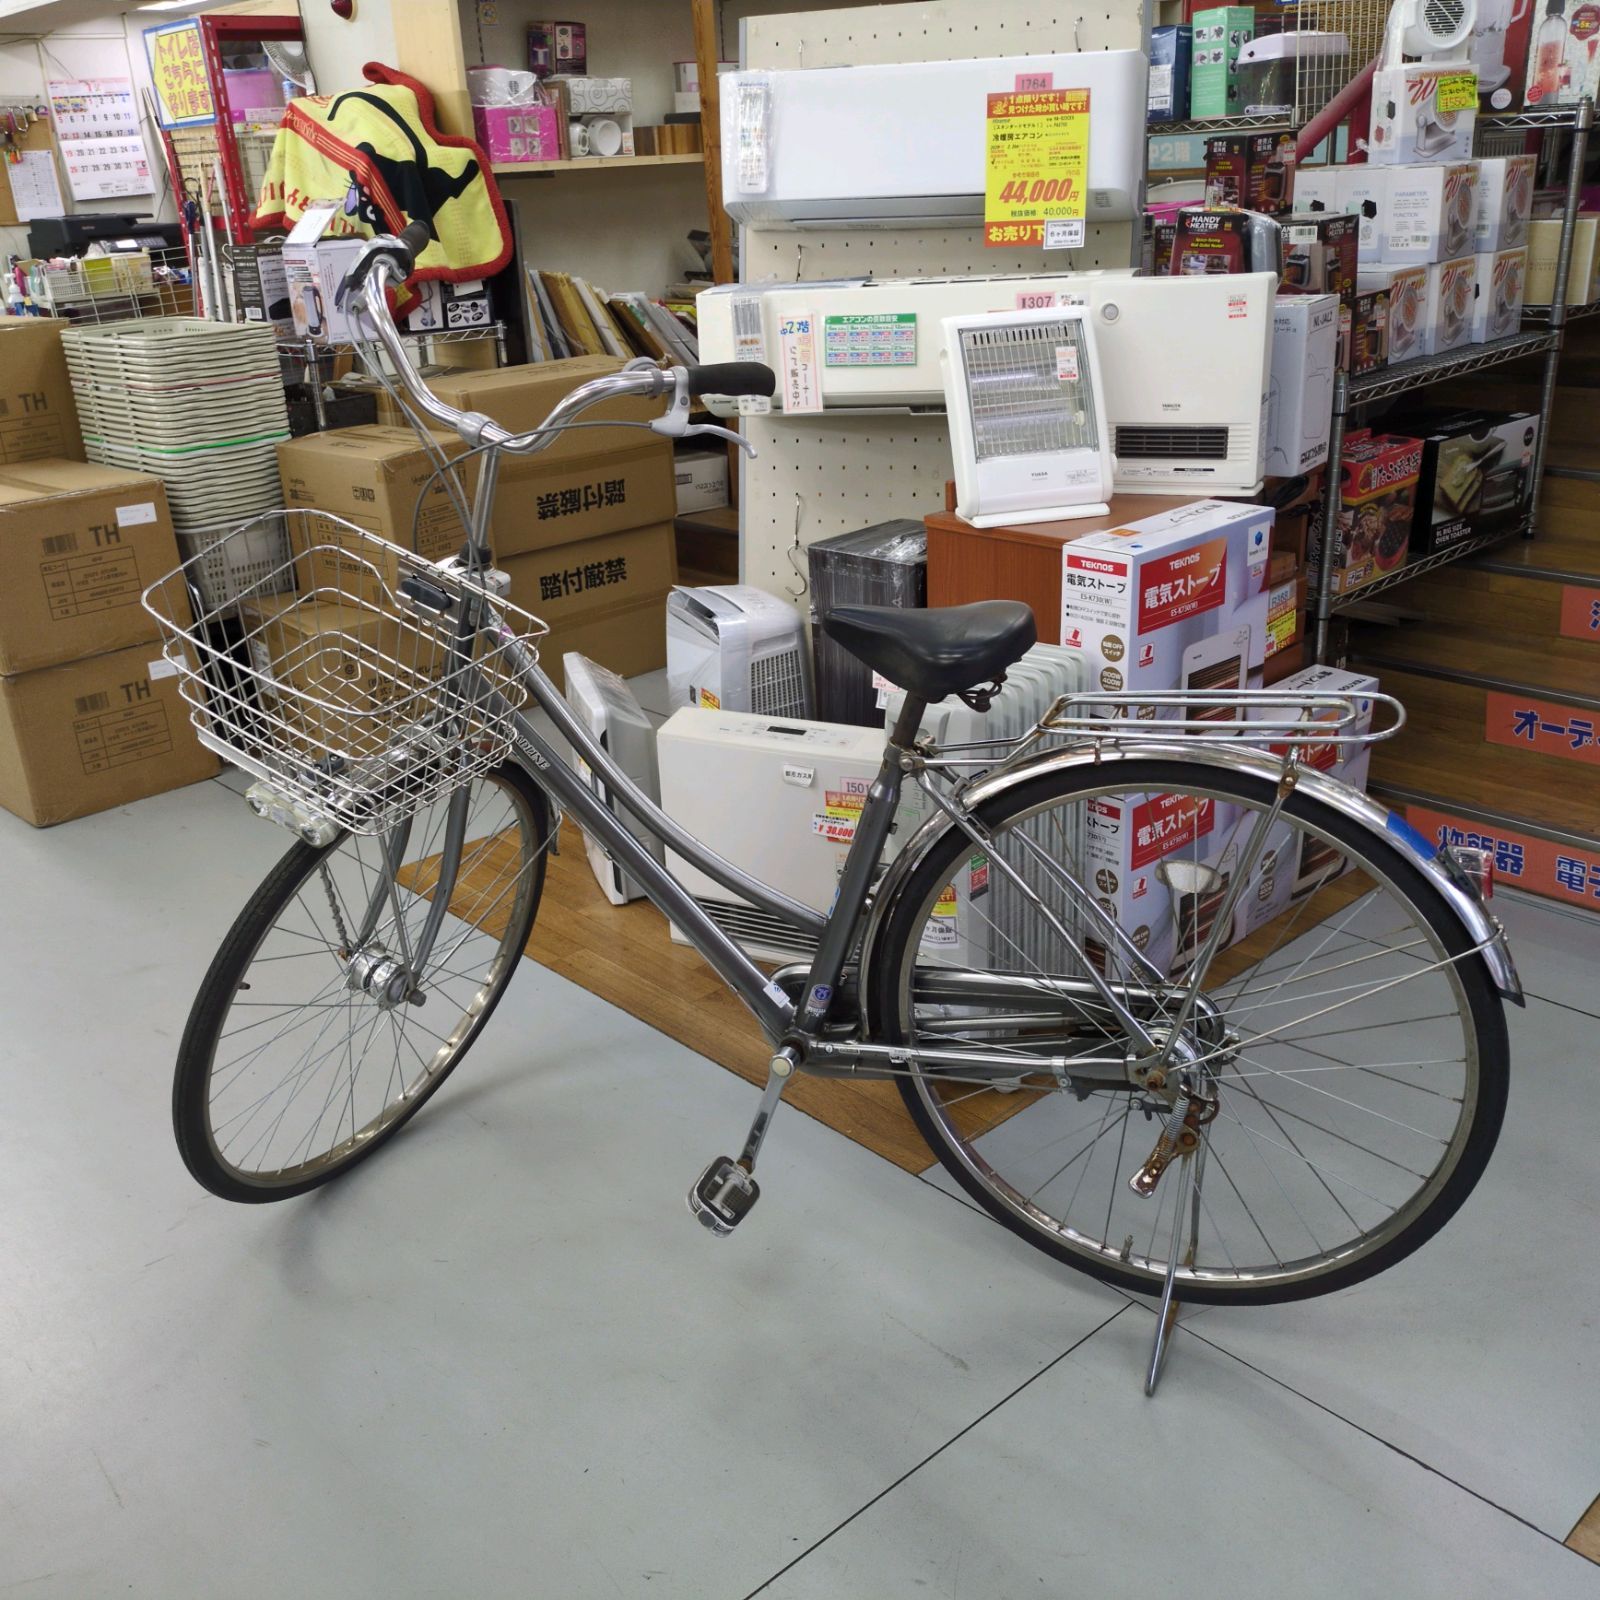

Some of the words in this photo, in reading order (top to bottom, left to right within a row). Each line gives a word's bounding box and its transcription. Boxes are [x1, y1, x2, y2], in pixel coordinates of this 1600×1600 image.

[1189, 221, 1219, 230] HEATER
[1190, 215, 1221, 223] HANDY
[18, 391, 48, 412] TH
[88, 523, 121, 547] TH
[1080, 559, 1114, 572] TEKNOS
[1169, 552, 1201, 571] TEKNOS
[538, 557, 627, 600] 踏付厳禁
[1066, 572, 1127, 594] 電気ストーブ
[1144, 562, 1222, 609] 電気ストーブ
[120, 679, 151, 704] TH
